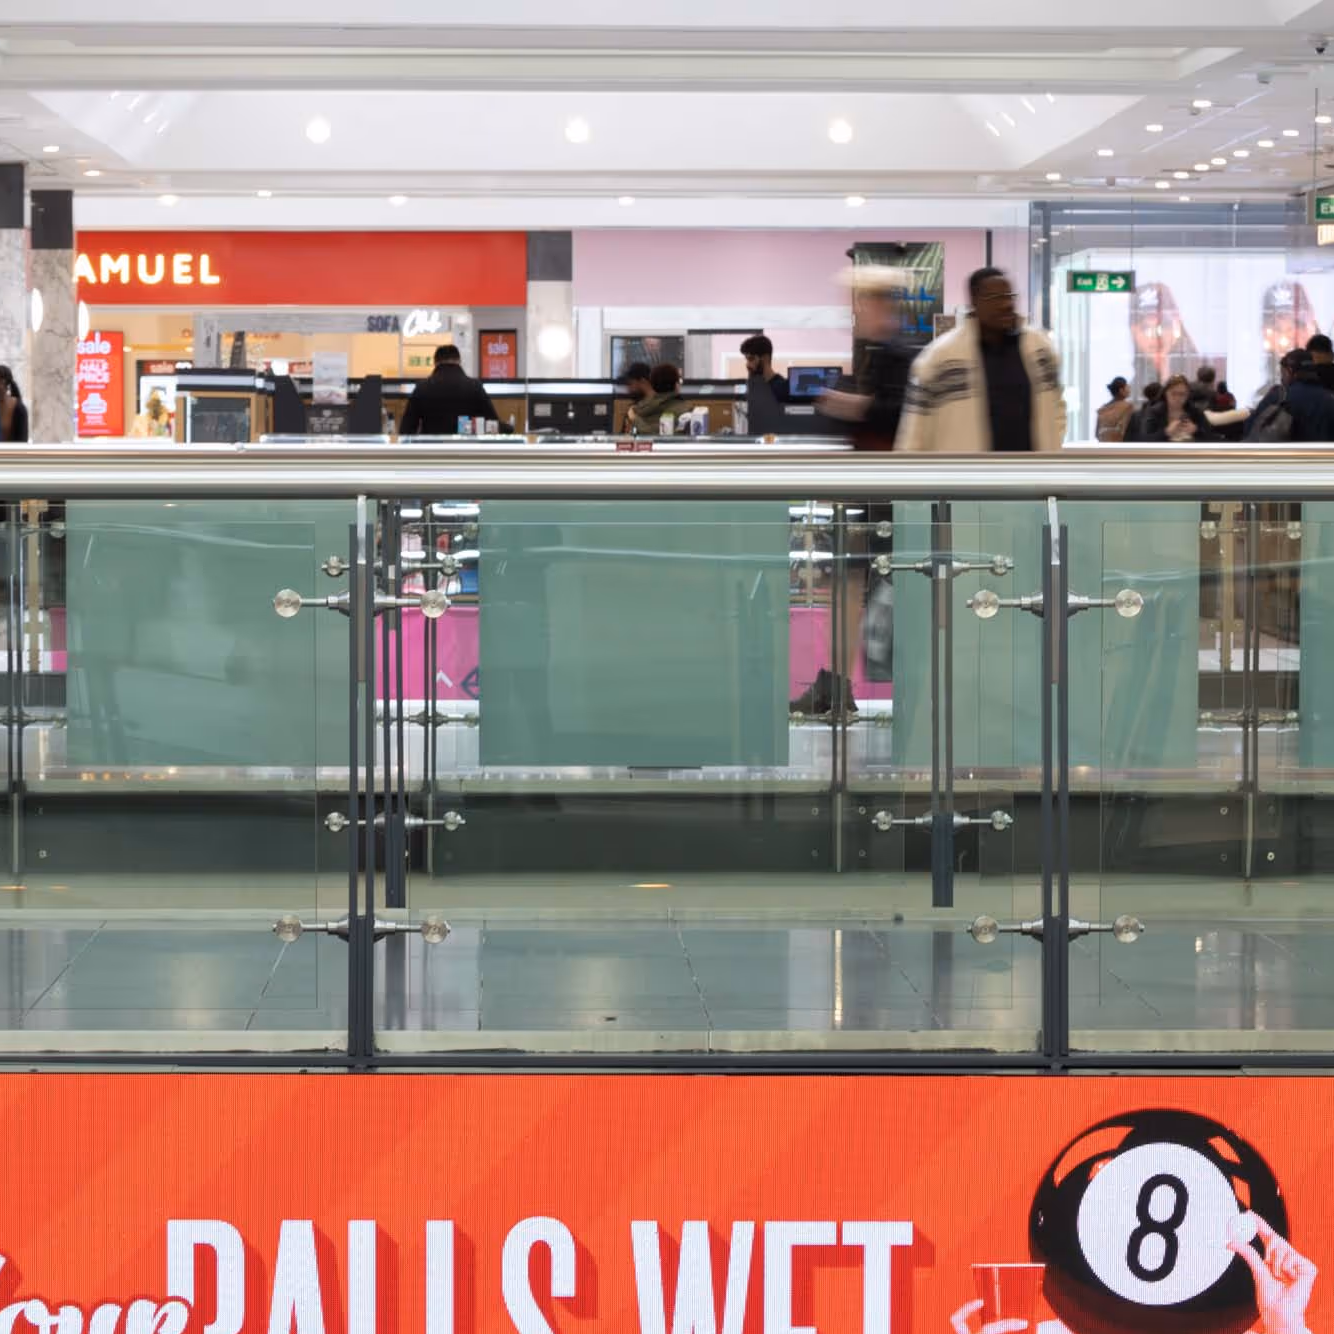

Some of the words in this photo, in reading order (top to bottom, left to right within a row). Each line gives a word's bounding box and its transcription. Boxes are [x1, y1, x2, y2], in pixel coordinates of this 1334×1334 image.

[72, 253, 221, 285] AMUEL
[367, 315, 400, 332] SOFA
[1126, 1173, 1190, 1283] 8
